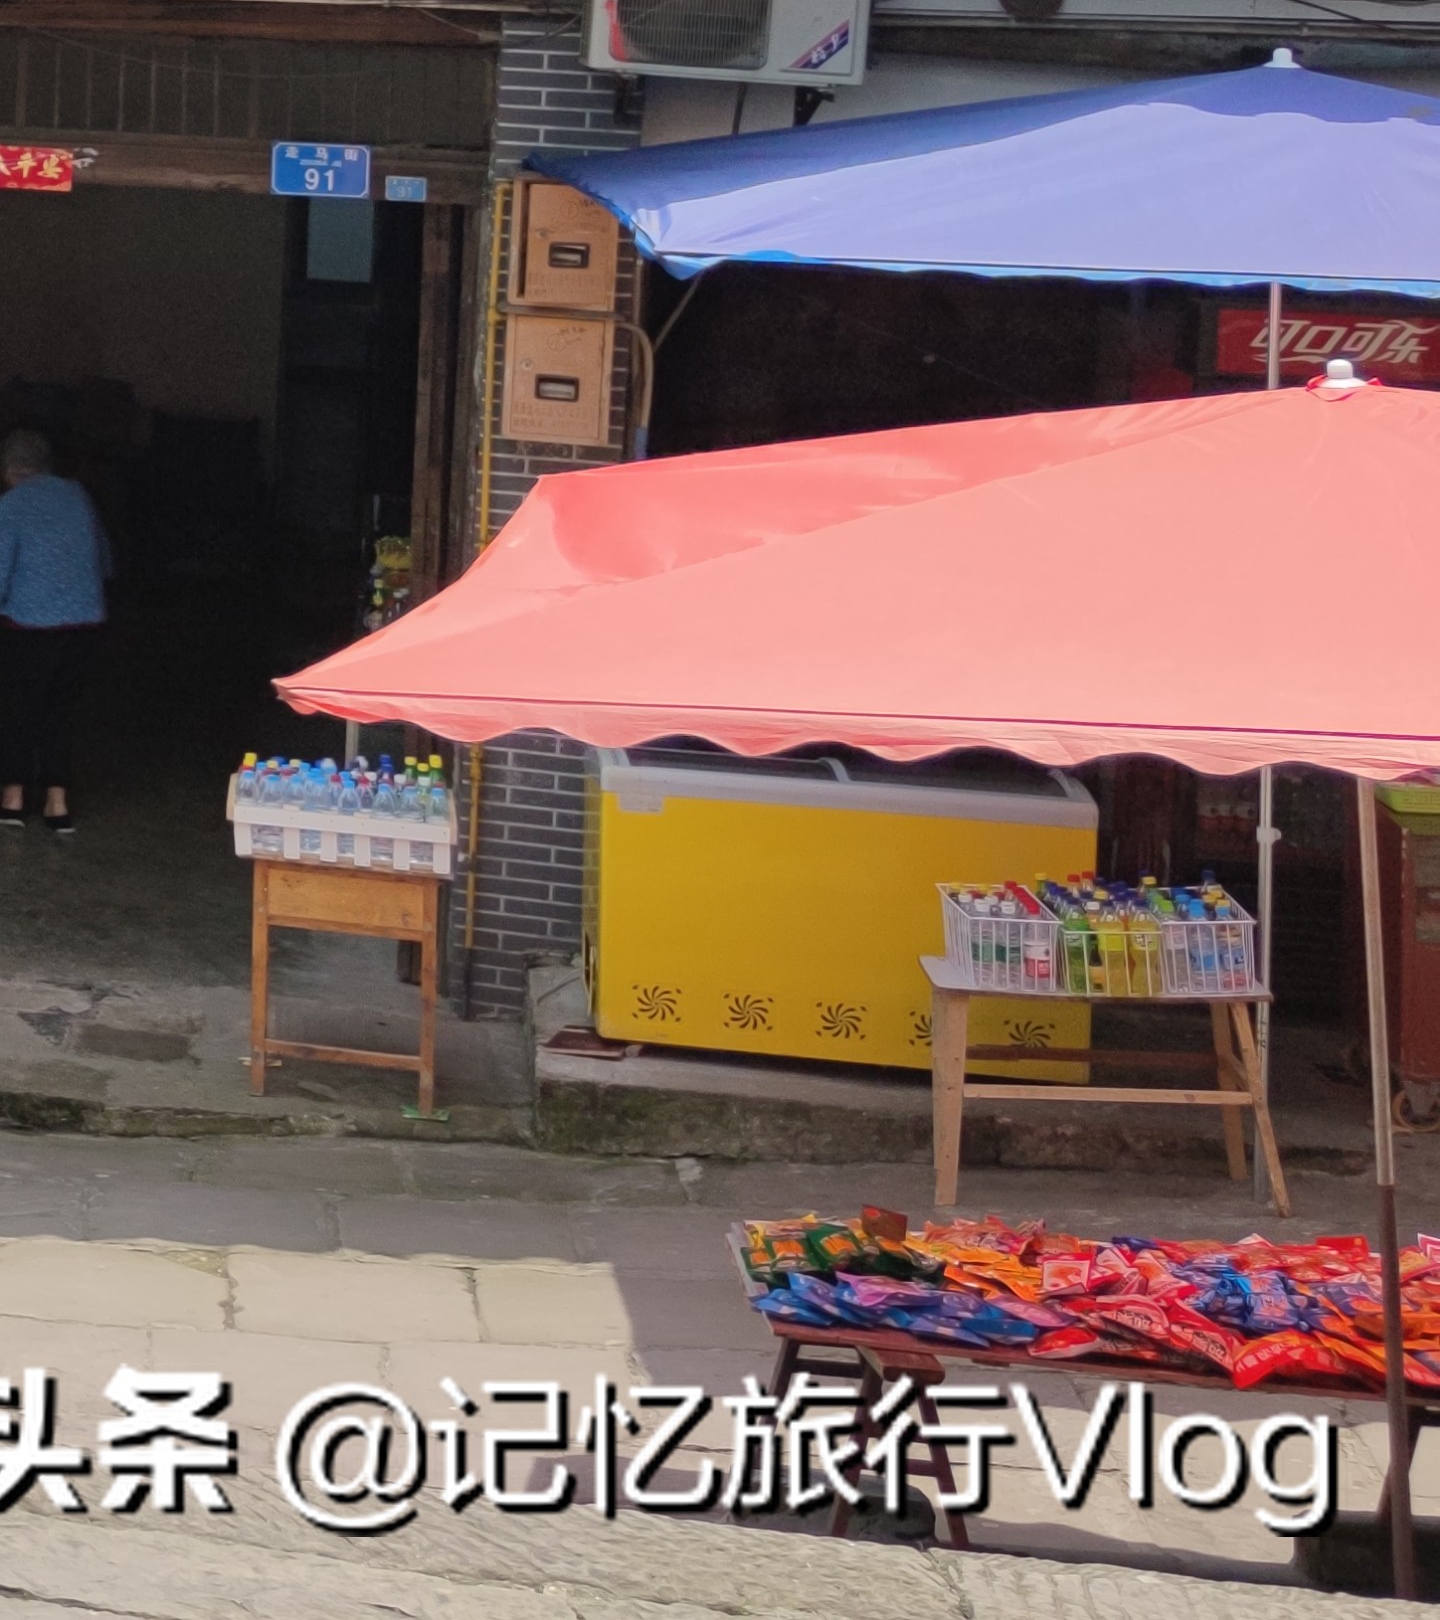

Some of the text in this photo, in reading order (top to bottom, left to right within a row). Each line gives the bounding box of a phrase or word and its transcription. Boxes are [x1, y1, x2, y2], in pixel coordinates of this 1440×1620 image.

[304, 168, 335, 192] 91
[1249, 318, 1438, 364] 可口可乐
